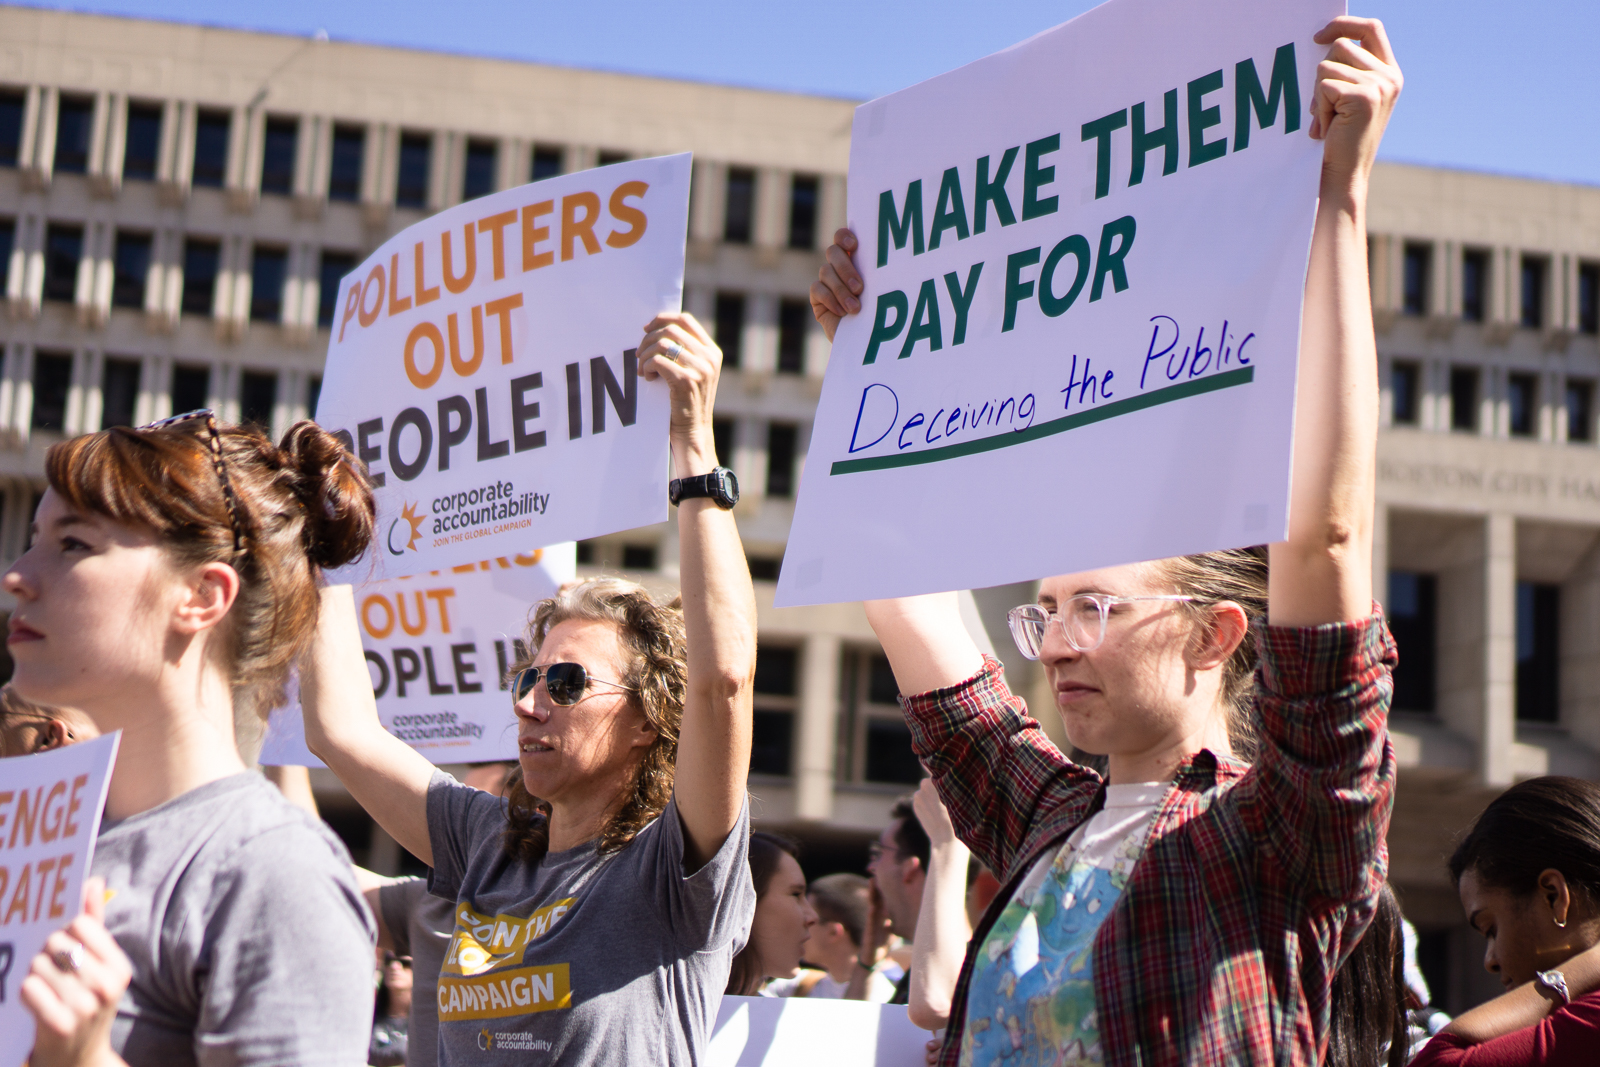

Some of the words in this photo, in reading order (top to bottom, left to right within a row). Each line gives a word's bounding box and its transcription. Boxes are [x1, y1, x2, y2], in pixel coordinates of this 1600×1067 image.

[876, 133, 1061, 269] MAKE
[1081, 42, 1302, 200] THEM
[338, 180, 651, 344] POLLUTERS
[862, 261, 985, 366] PAY
[1001, 215, 1137, 334] FOR
[403, 292, 525, 390] OUT
[565, 347, 639, 441] IN
[848, 383, 1036, 454] Deceiving
[1060, 354, 1115, 410] the
[1139, 315, 1257, 390] Public
[432, 480, 514, 513] corporate
[432, 492, 550, 534] accountability
[432, 536, 450, 548] JOIN
[451, 534, 463, 544] THE
[464, 529, 493, 540] GLOBAL
[493, 519, 532, 534] CAMPAIGN
[361, 588, 456, 640] OUT
[393, 711, 458, 728] corporate
[395, 723, 484, 740] accountability
[438, 972, 555, 1013] CAMPAIGN
[495, 1031, 533, 1043] corporate
[496, 1039, 552, 1051] accountability
